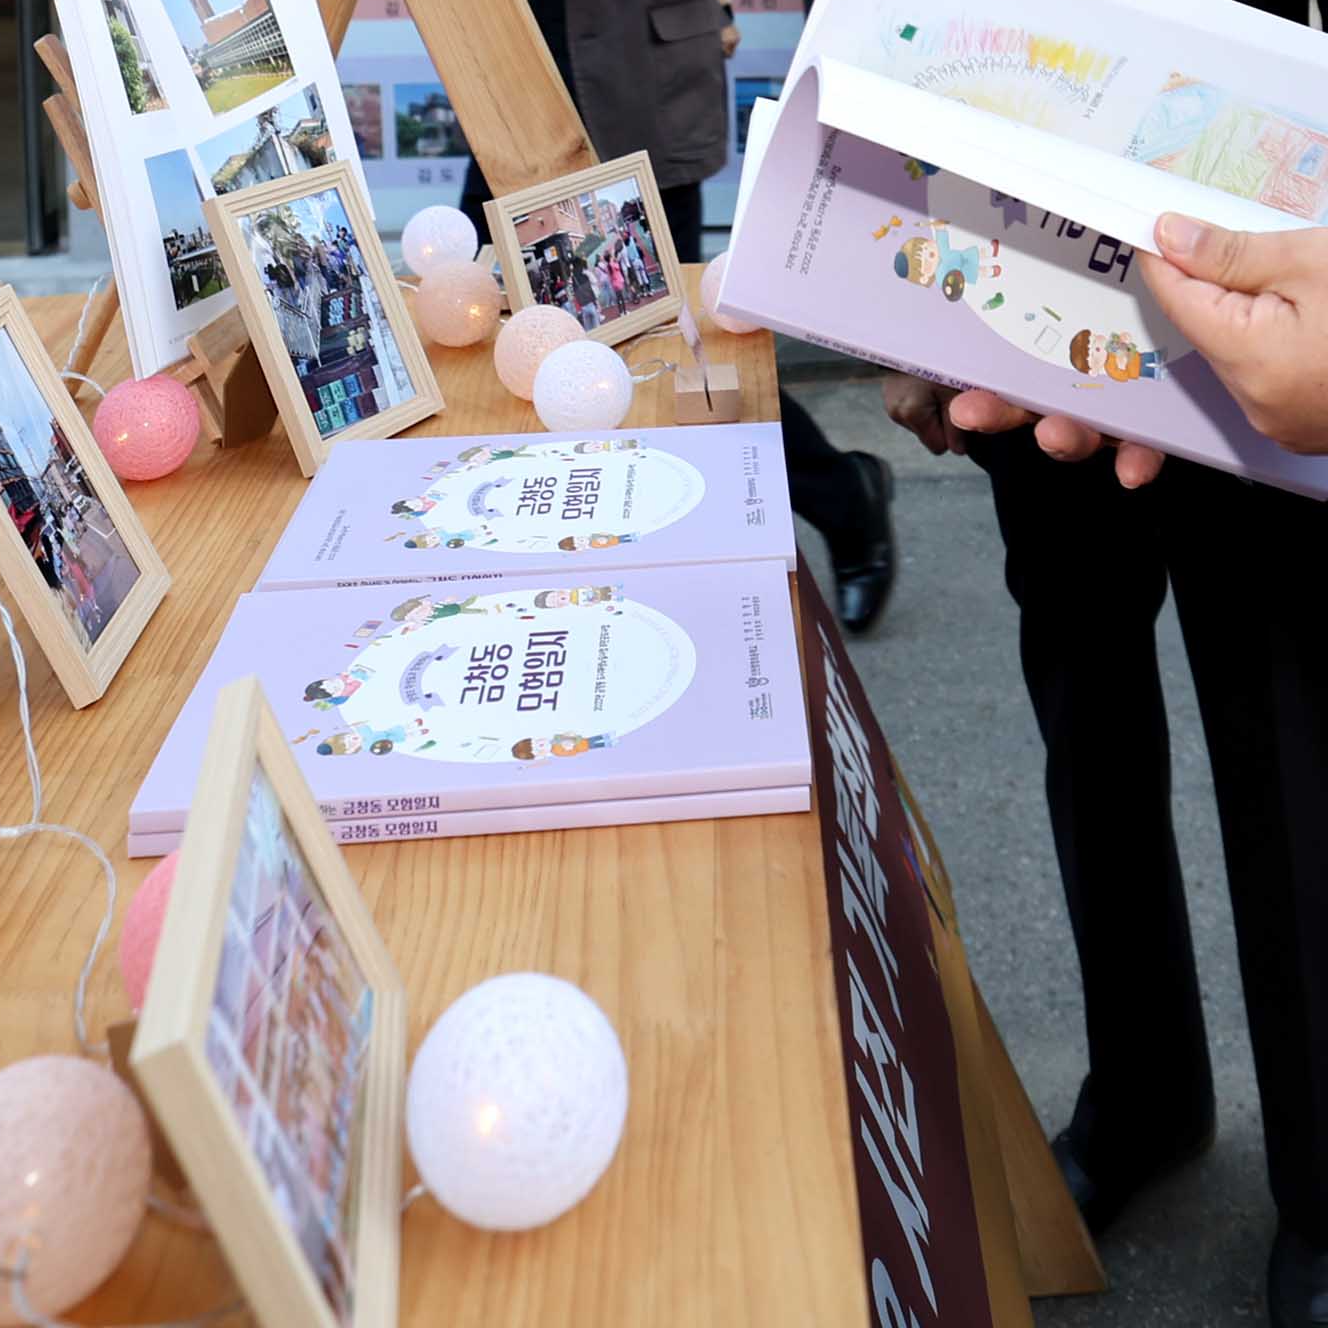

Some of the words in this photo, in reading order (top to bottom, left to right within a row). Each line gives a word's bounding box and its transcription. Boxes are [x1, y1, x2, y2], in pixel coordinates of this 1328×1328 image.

[515, 475, 558, 518] 금창동
[561, 467, 603, 521] 모험일지
[460, 643, 513, 705] 금창동
[516, 630, 569, 712] 모험일지
[343, 799, 382, 816] 금창동
[387, 795, 440, 812] 모험일지
[341, 823, 380, 840] 금창동
[385, 820, 438, 837] 모험일지
